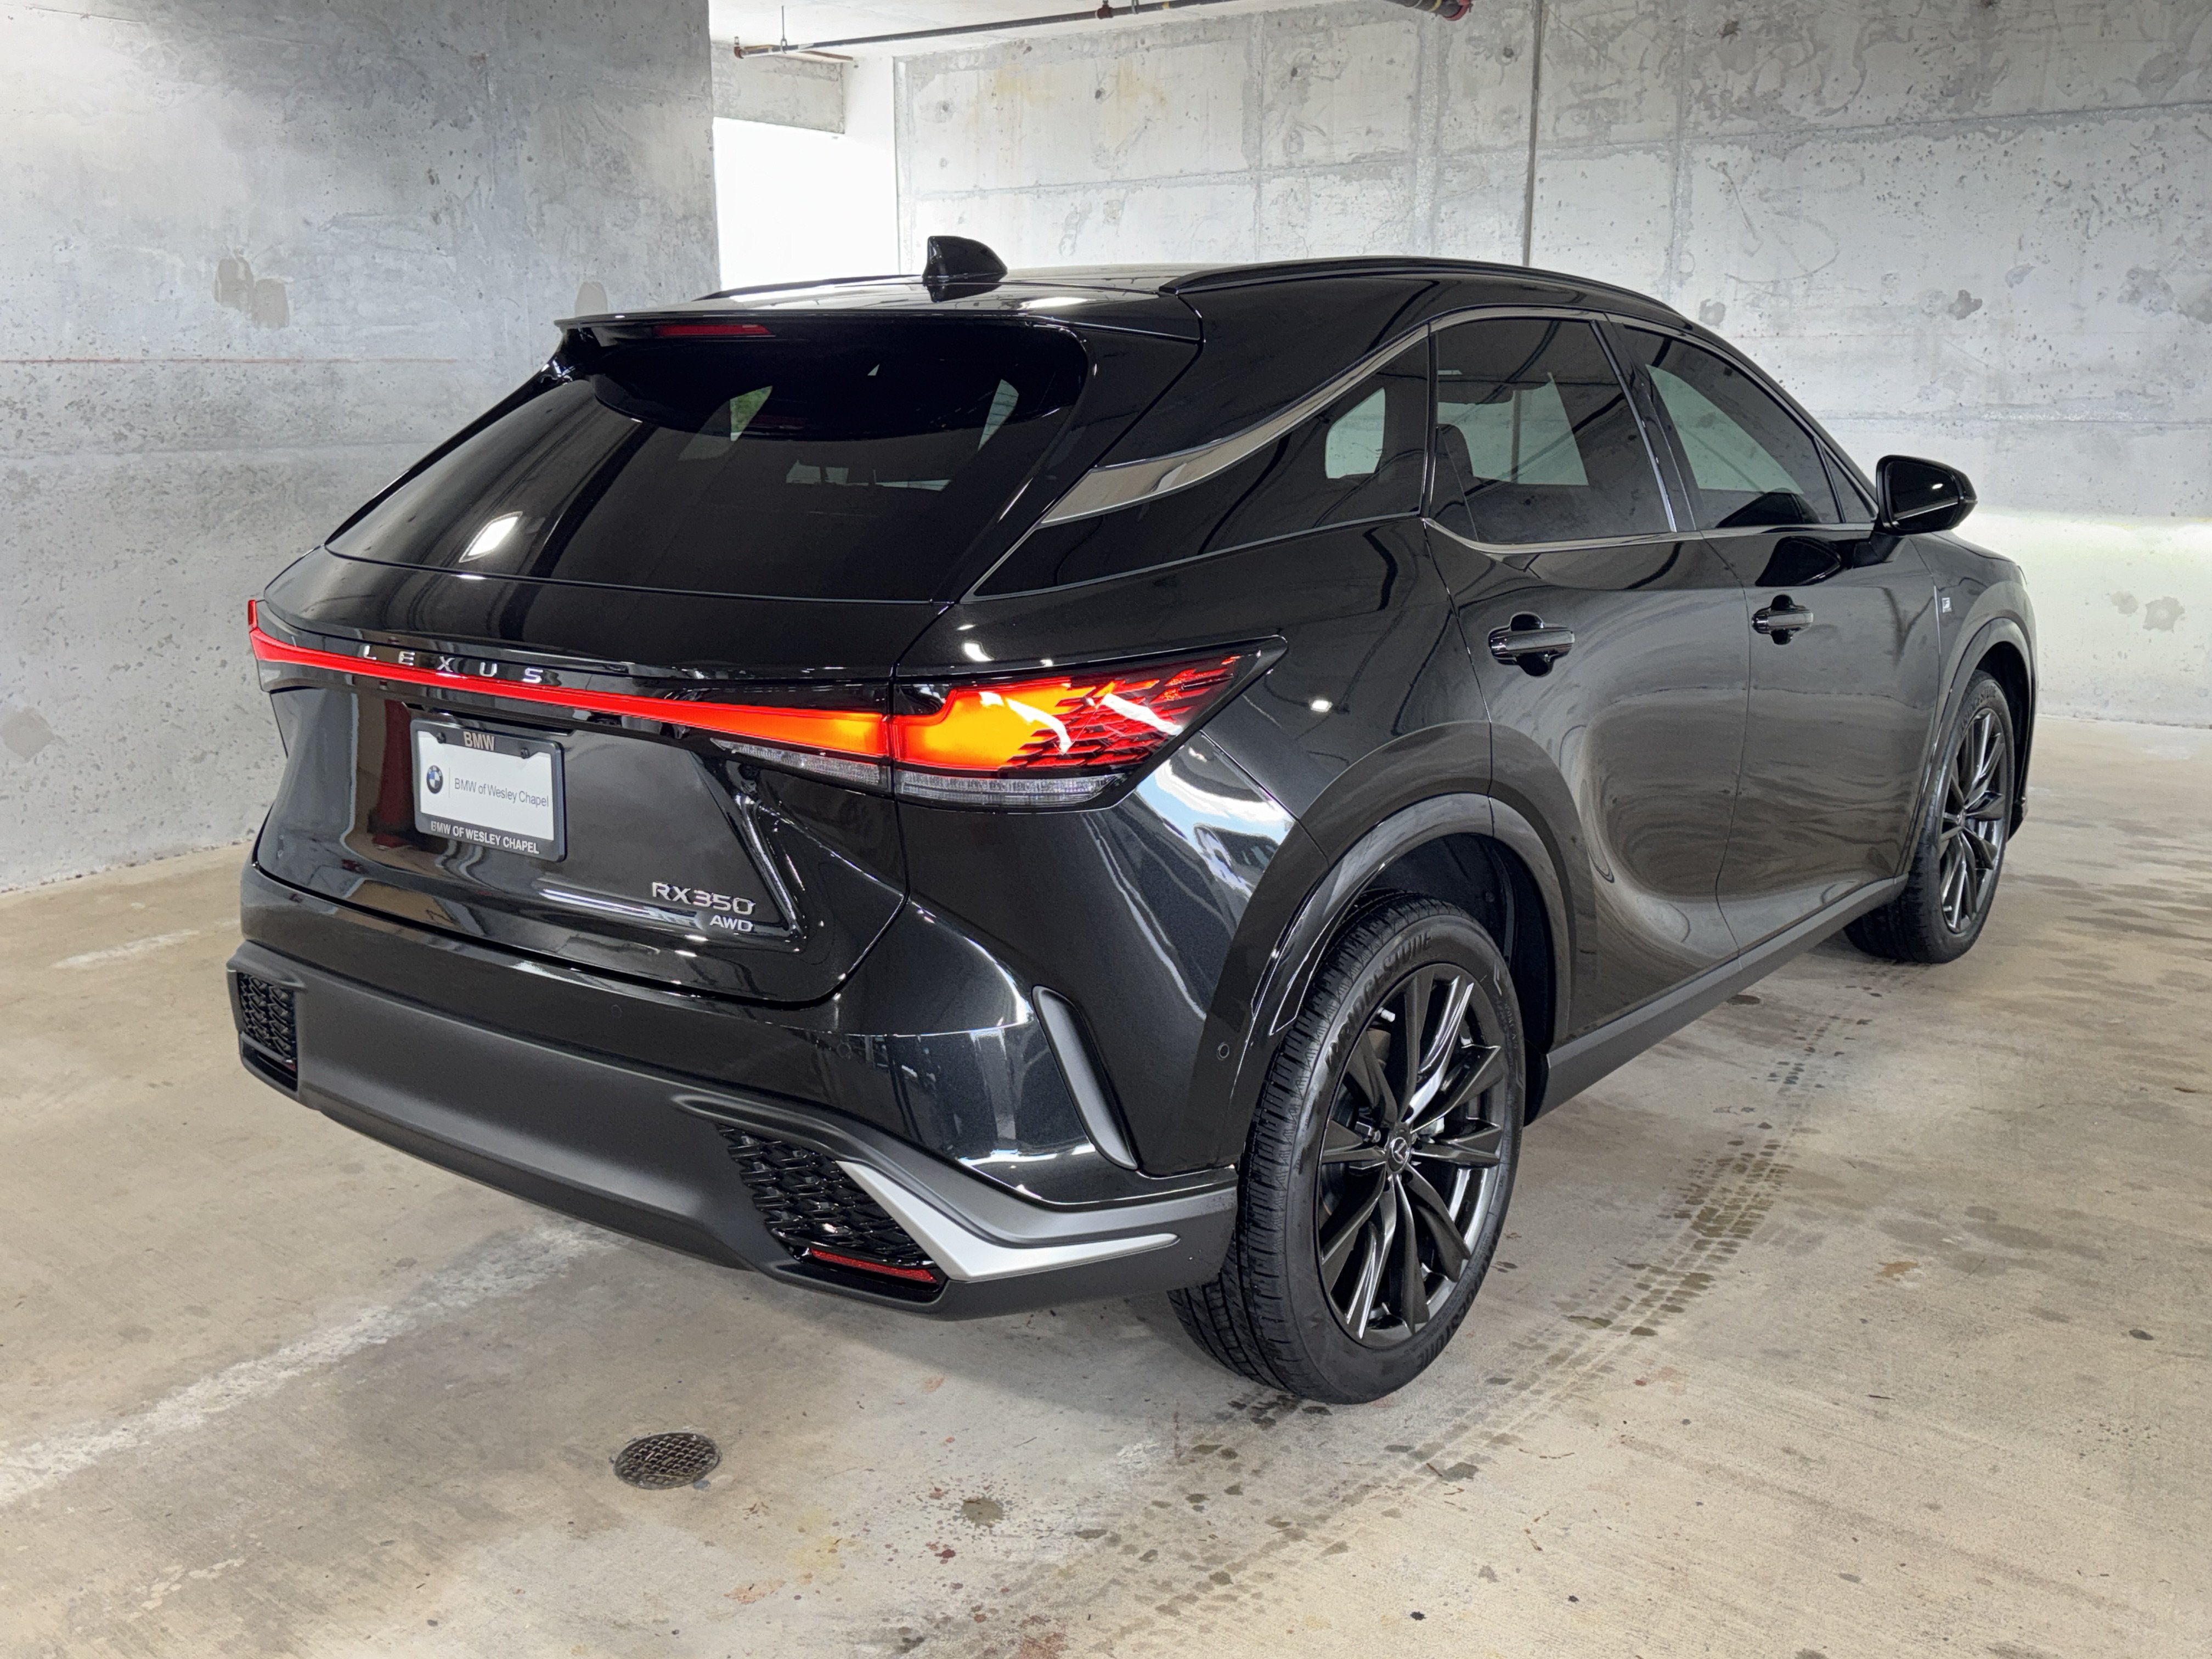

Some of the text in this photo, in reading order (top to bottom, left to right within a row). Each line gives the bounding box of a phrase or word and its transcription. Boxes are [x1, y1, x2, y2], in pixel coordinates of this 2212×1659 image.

[363, 645, 544, 683] LEXUS
[463, 731, 494, 751] BMW
[455, 778, 549, 808] BMW of Wesley Chapel
[431, 821, 540, 854] BMW OF WESLEY CHAPEL
[709, 915, 753, 932] AWD
